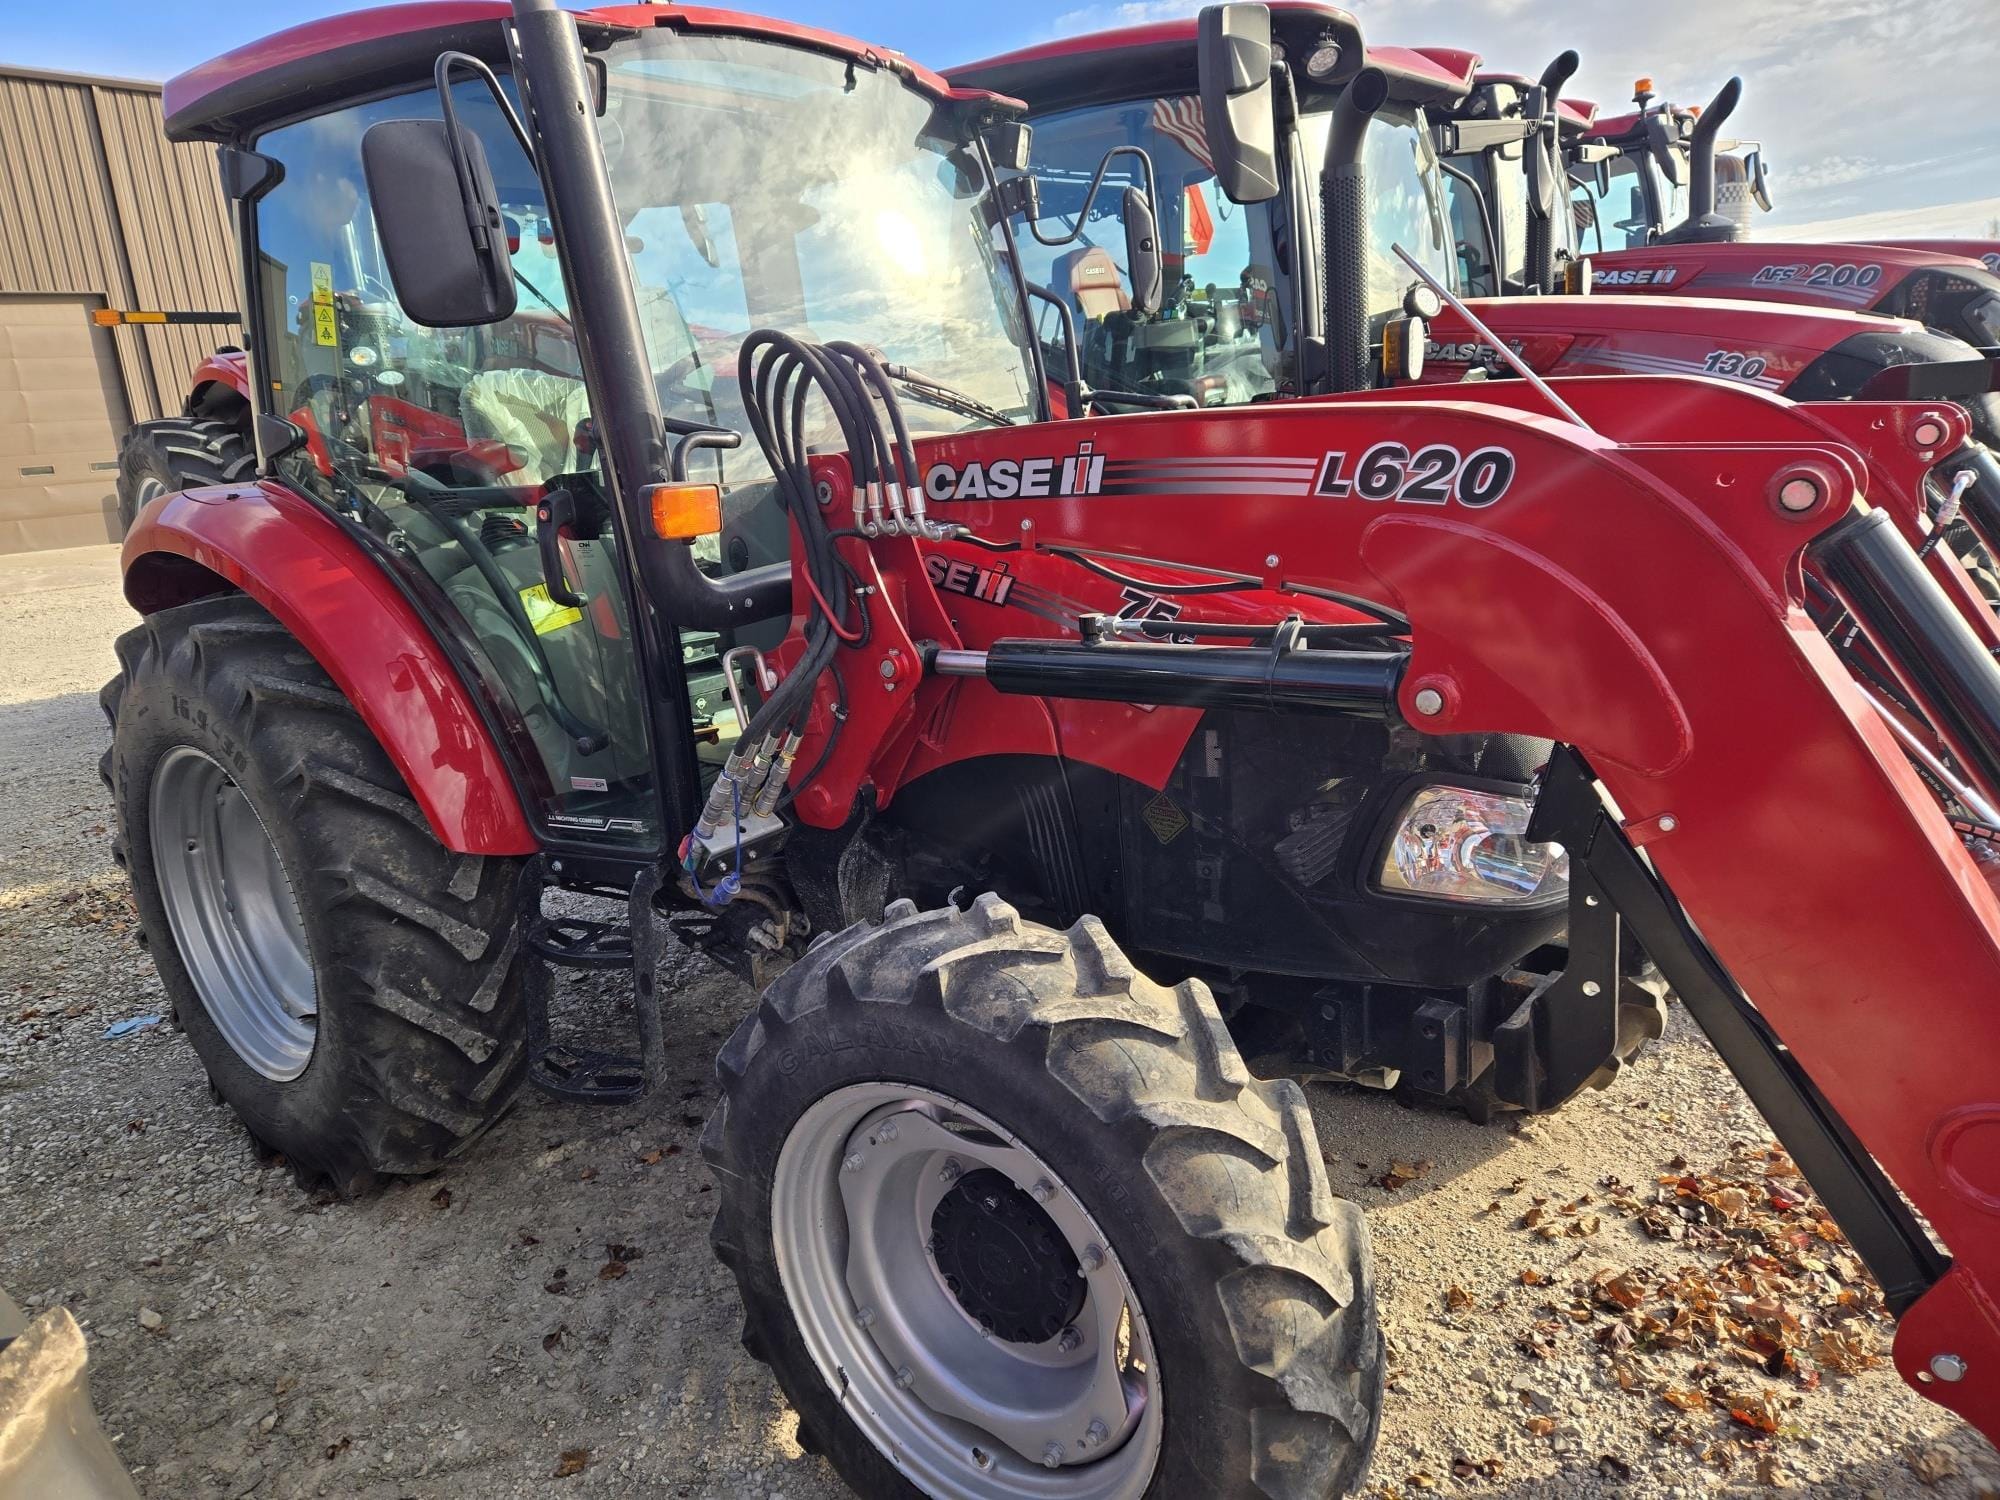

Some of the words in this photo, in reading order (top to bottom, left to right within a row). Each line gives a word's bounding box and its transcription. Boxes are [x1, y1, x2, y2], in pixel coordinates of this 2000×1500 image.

[1592, 268, 1650, 285] CASE
[1752, 265, 1796, 286] AFS
[1802, 263, 1882, 288] 200
[1703, 350, 1766, 381] 130
[925, 458, 1055, 501] CASE
[1058, 441, 1107, 495] IH
[1314, 441, 1515, 508] L620
[776, 1021, 960, 1077] GALAXY
